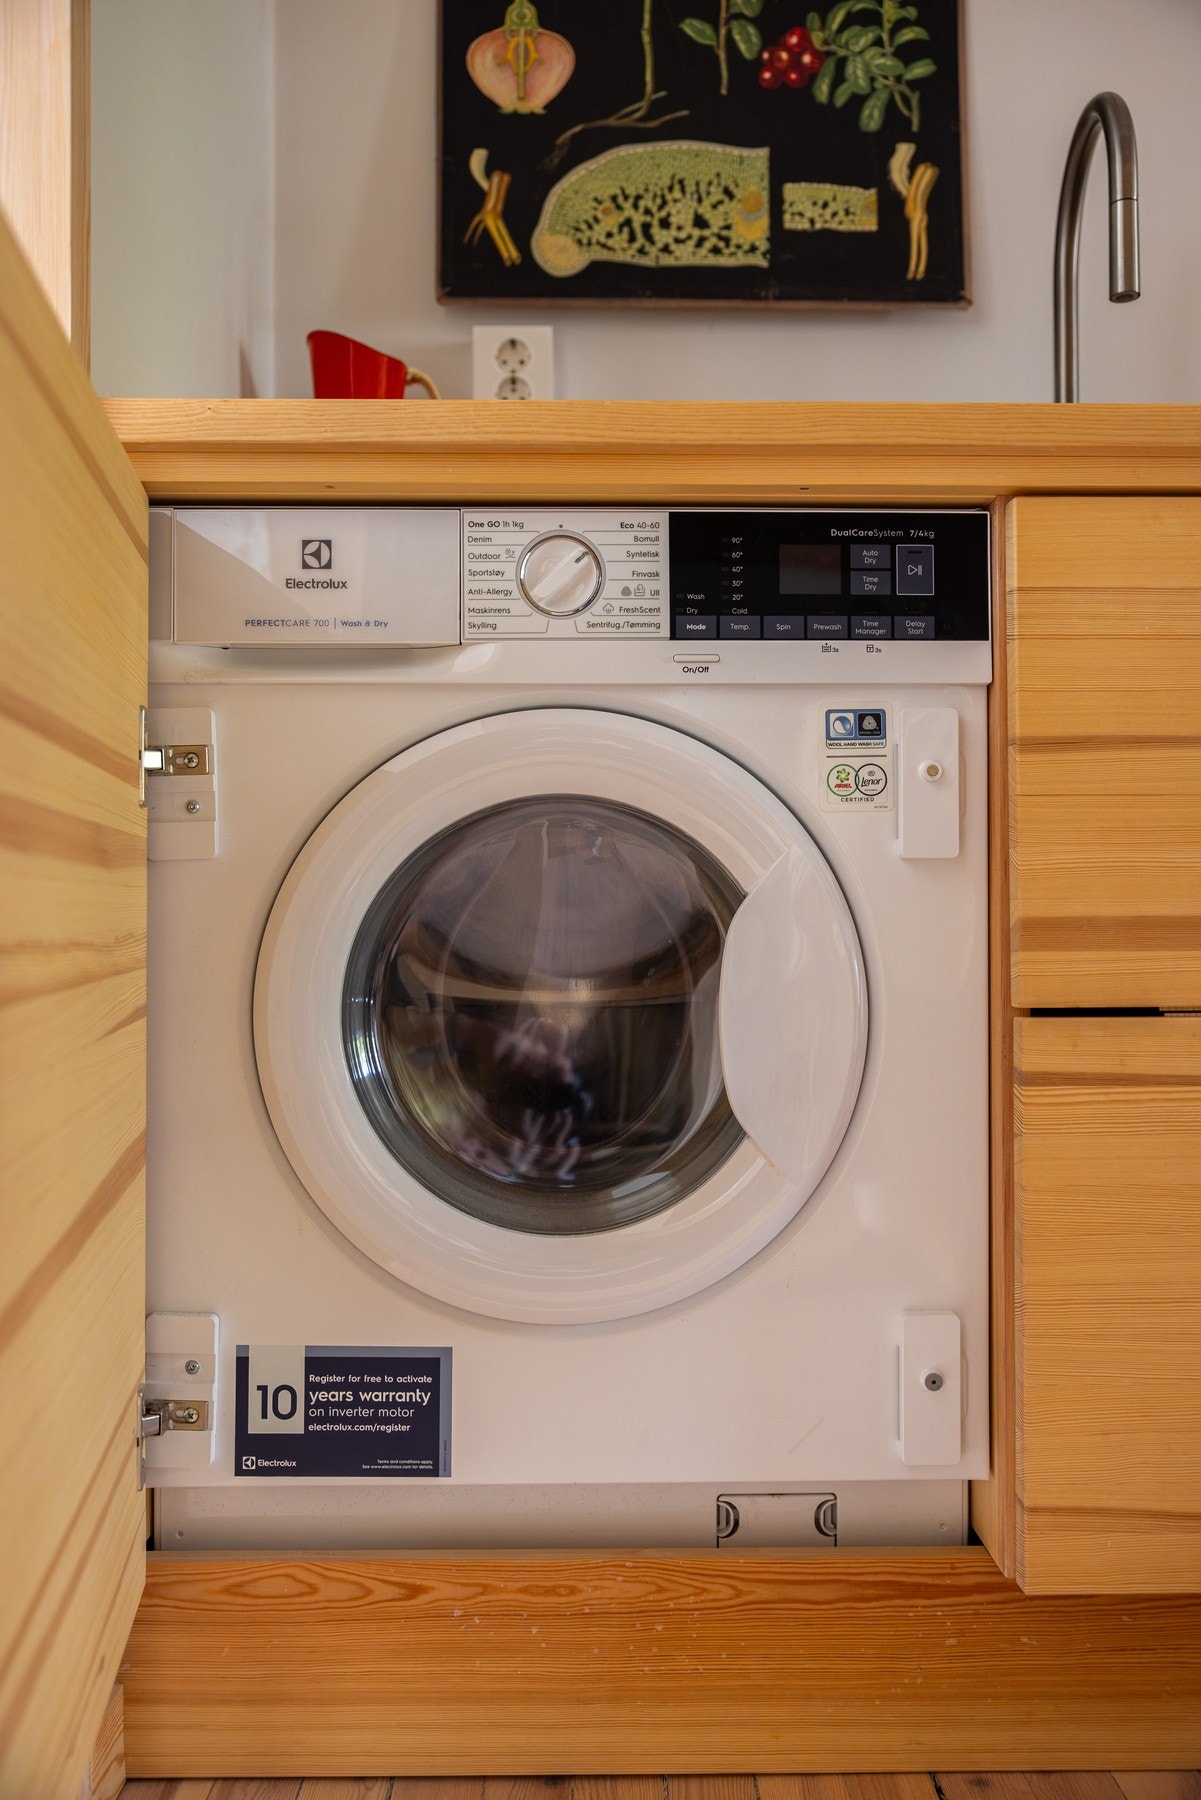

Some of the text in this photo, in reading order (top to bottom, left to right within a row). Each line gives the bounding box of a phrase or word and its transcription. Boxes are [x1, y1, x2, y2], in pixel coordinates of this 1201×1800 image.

[512, 520, 524, 529] 1kg
[830, 529, 934, 540] DualCareSystem 7/4kg
[626, 550, 660, 559] Syntetisk
[864, 557, 876, 565] Dry
[468, 569, 505, 577] Sportstøy
[285, 578, 348, 590] Electrolux
[864, 583, 876, 592] Dry
[468, 588, 513, 597] Anti-Allergy
[245, 619, 310, 627] PERFECTCARE
[314, 619, 330, 627] 700
[374, 620, 388, 629] Dry
[468, 621, 497, 630] Skylling
[730, 623, 751, 632] Temp.
[776, 623, 791, 632] Spin
[905, 620, 926, 628] Delay
[855, 627, 886, 636] Manager
[682, 666, 710, 674] On/Off
[860, 777, 882, 787] Lenor
[309, 1374, 345, 1384] Register
[348, 1374, 361, 1382] for
[364, 1374, 382, 1383] free
[396, 1375, 432, 1383] activate
[309, 1389, 431, 1405] years warranty
[256, 1384, 298, 1421] 10
[309, 1407, 414, 1417] on inverter motor
[308, 1423, 411, 1433] electrolux.com/register
[257, 1459, 296, 1467] Electrolux
